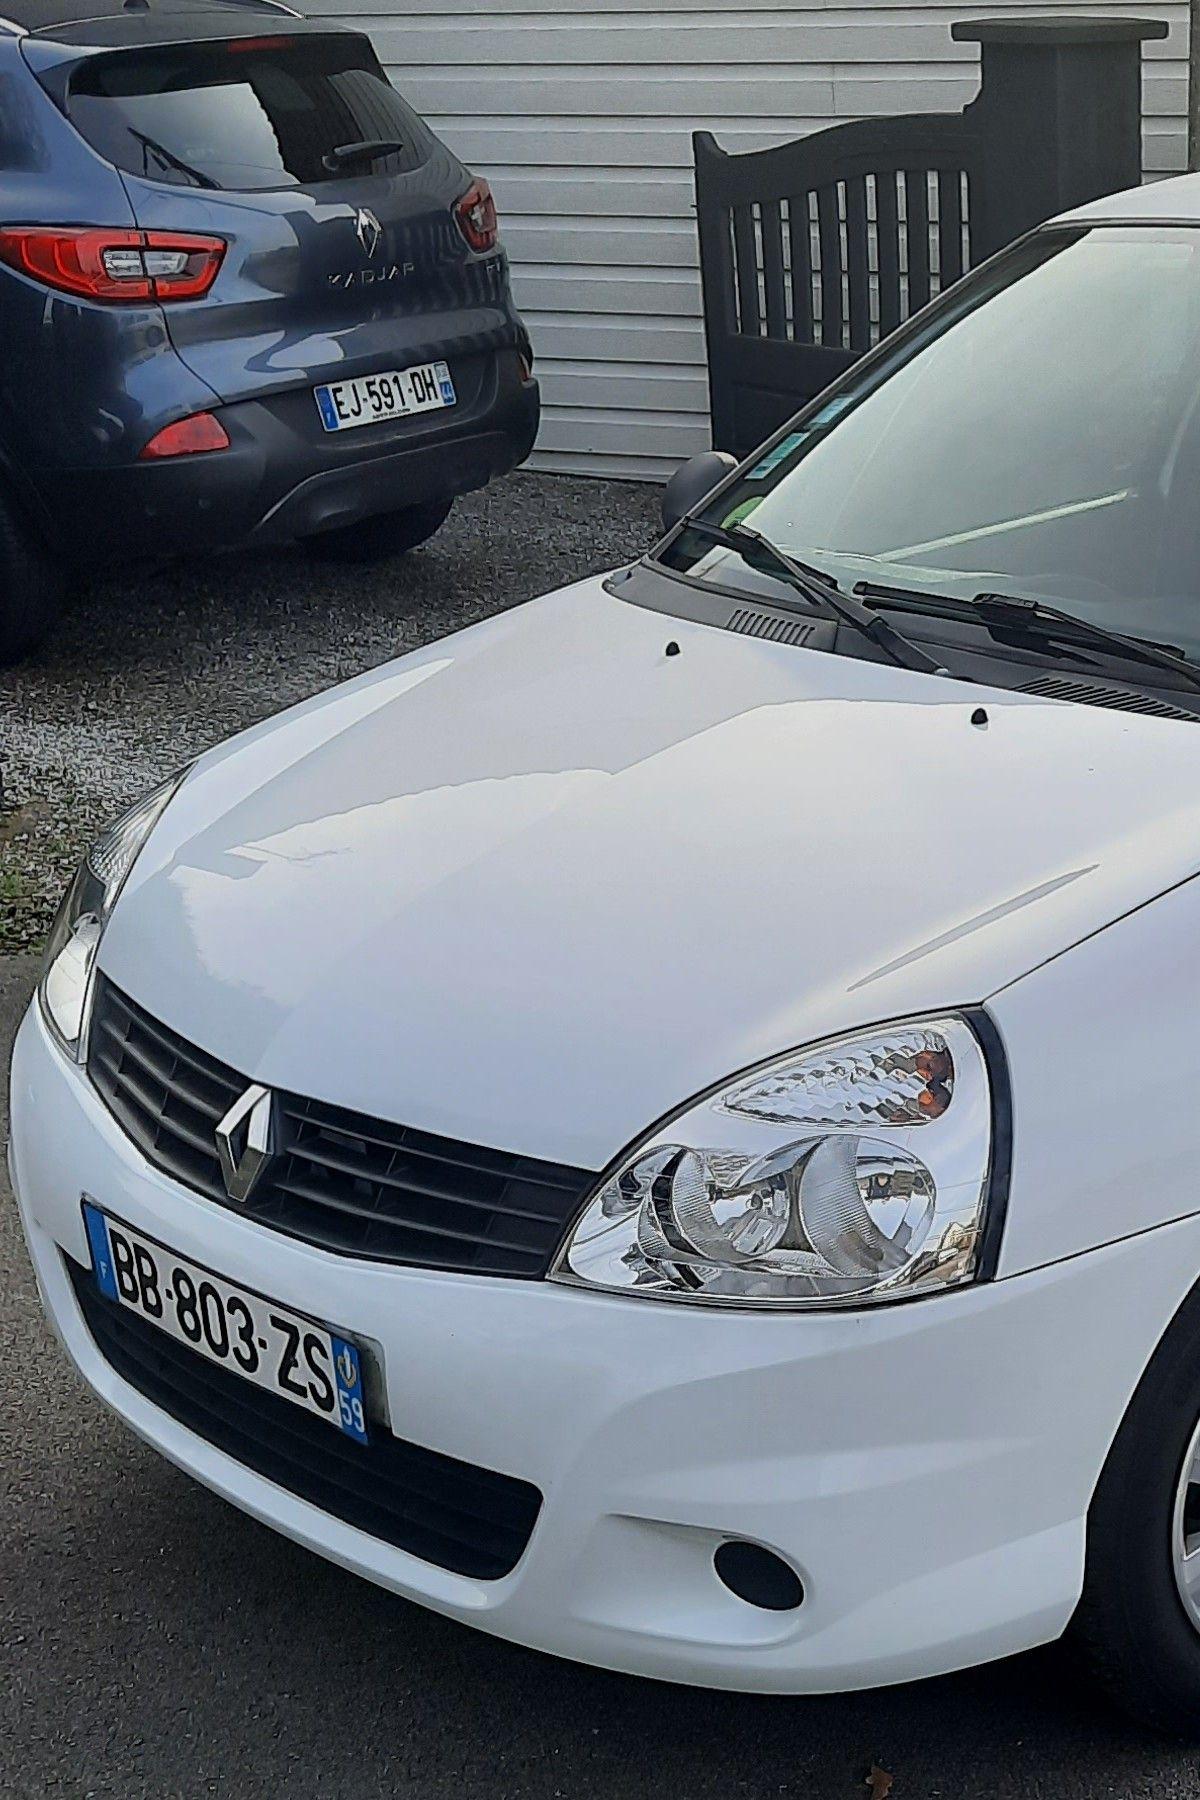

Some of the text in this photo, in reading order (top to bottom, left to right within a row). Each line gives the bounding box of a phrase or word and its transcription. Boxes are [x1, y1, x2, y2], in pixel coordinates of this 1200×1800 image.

[332, 368, 439, 420] EJ-591-DH
[99, 1260, 107, 1280] F
[109, 1227, 335, 1413] BB-803-ZS
[339, 1388, 365, 1433] 59
